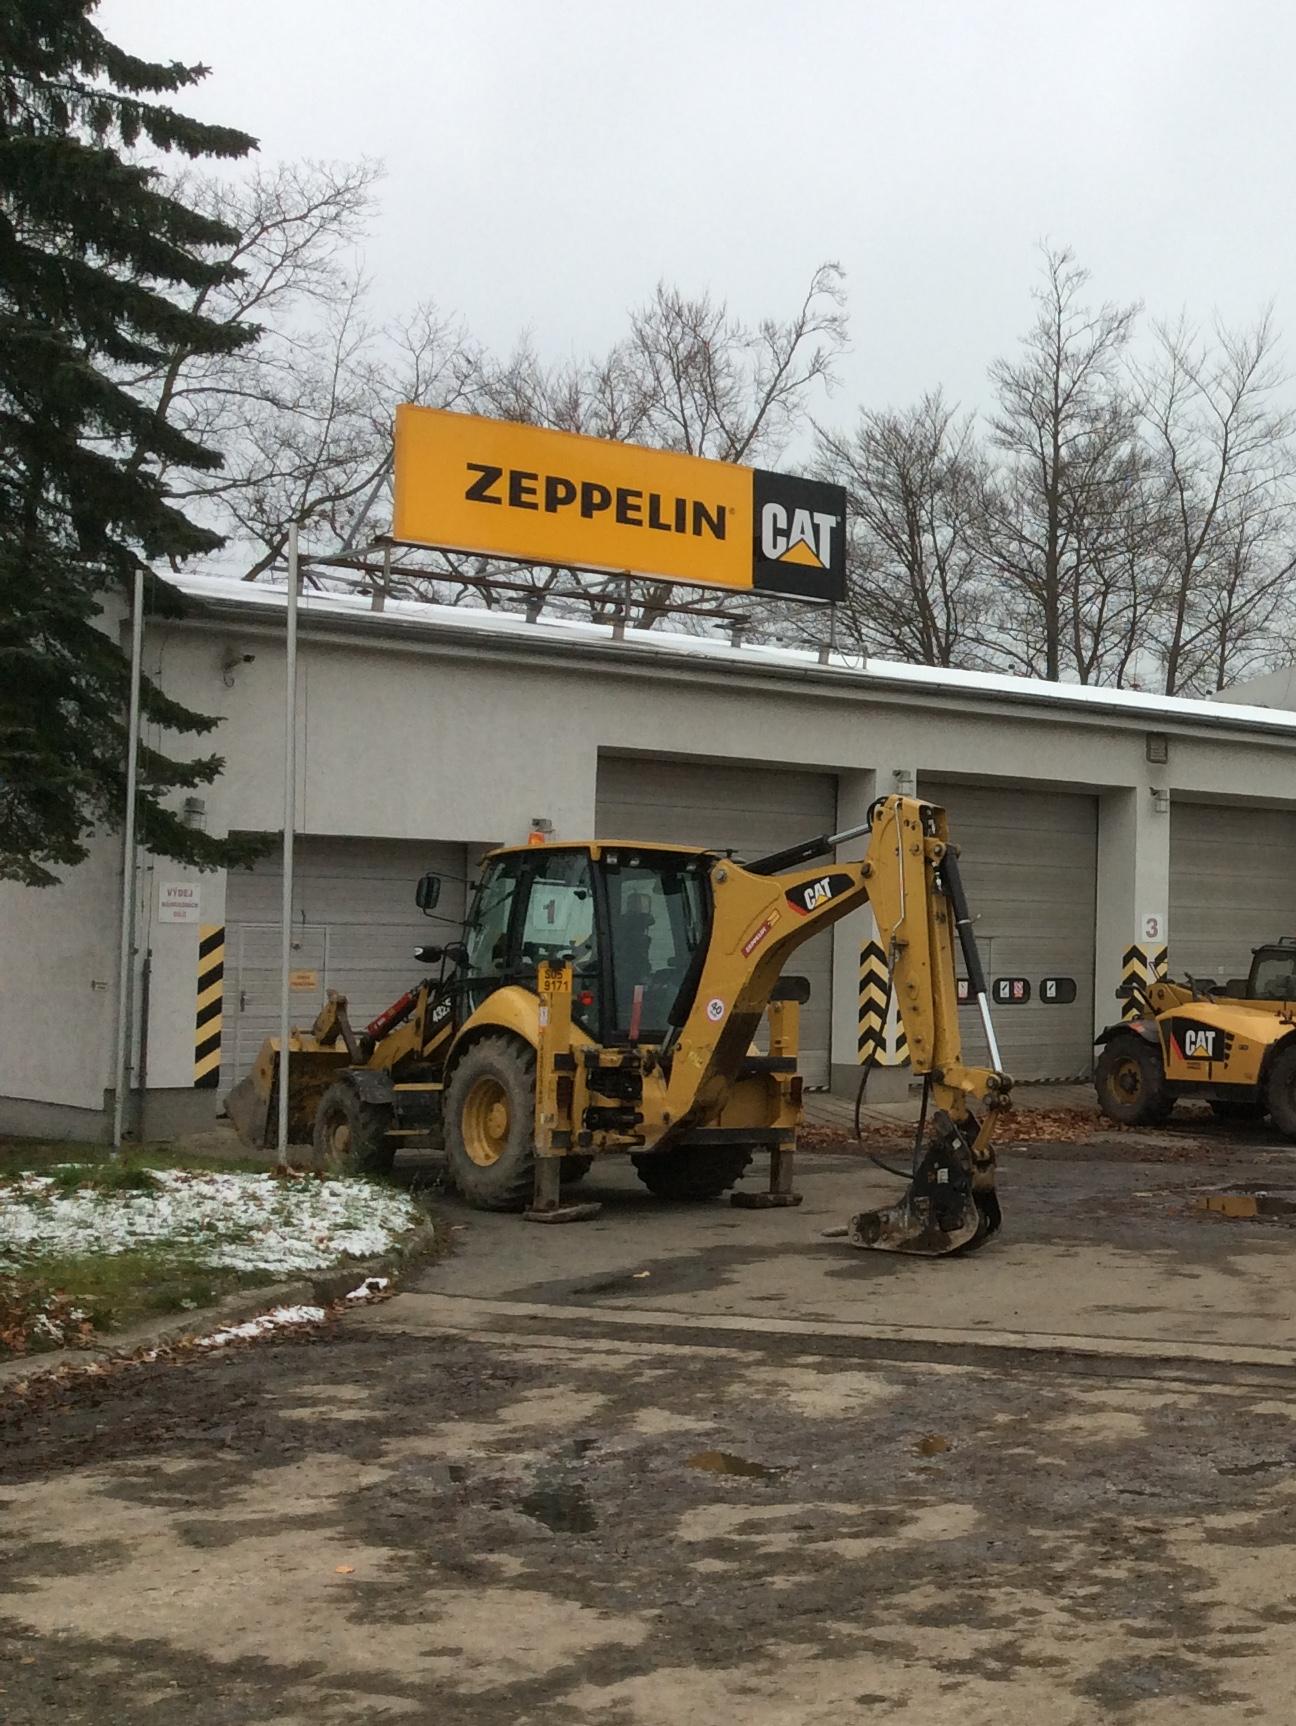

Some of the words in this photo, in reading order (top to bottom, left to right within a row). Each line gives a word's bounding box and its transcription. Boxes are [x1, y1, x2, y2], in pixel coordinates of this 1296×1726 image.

[464, 462, 727, 541] ZEPPELIN
[761, 502, 837, 570] CAT
[804, 877, 832, 910] CAT
[542, 899, 556, 924] 1
[1146, 918, 1158, 938] 3
[544, 968, 563, 980] S05
[544, 980, 569, 991] 9171
[1185, 1029, 1216, 1057] CAT
